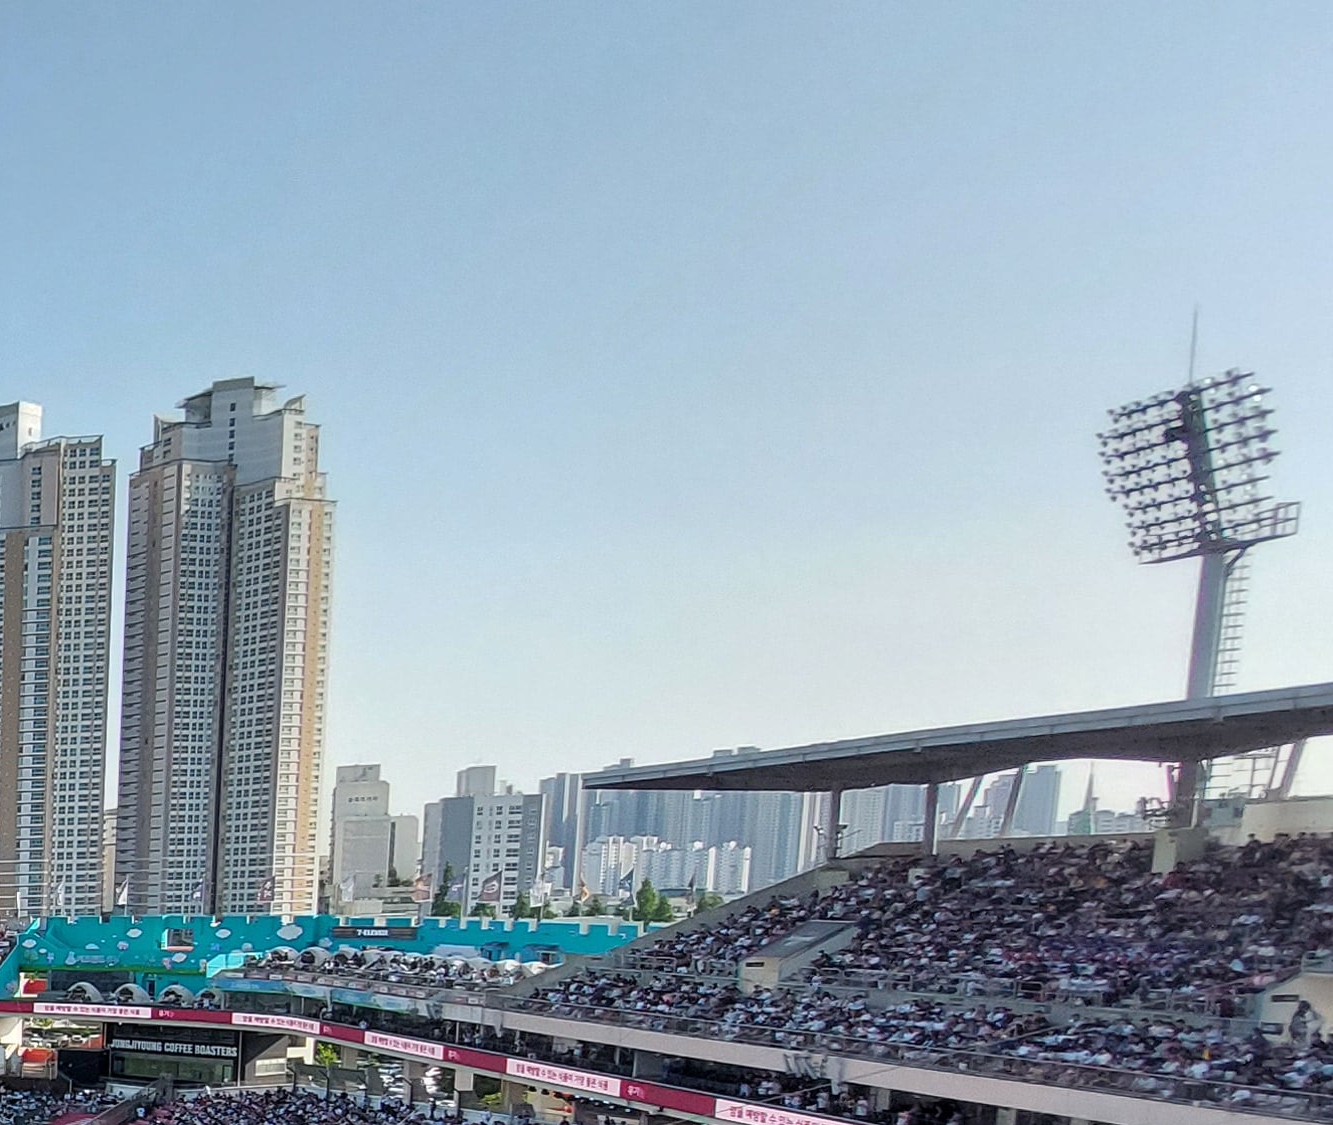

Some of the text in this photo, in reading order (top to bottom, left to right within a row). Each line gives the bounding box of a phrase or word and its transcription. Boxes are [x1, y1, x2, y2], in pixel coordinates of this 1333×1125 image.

[164, 1043, 193, 1054] COFFEE
[195, 1045, 237, 1057] ROASTERS
[745, 1108, 768, 1123] 예방할
[769, 1115, 777, 1124] 수
